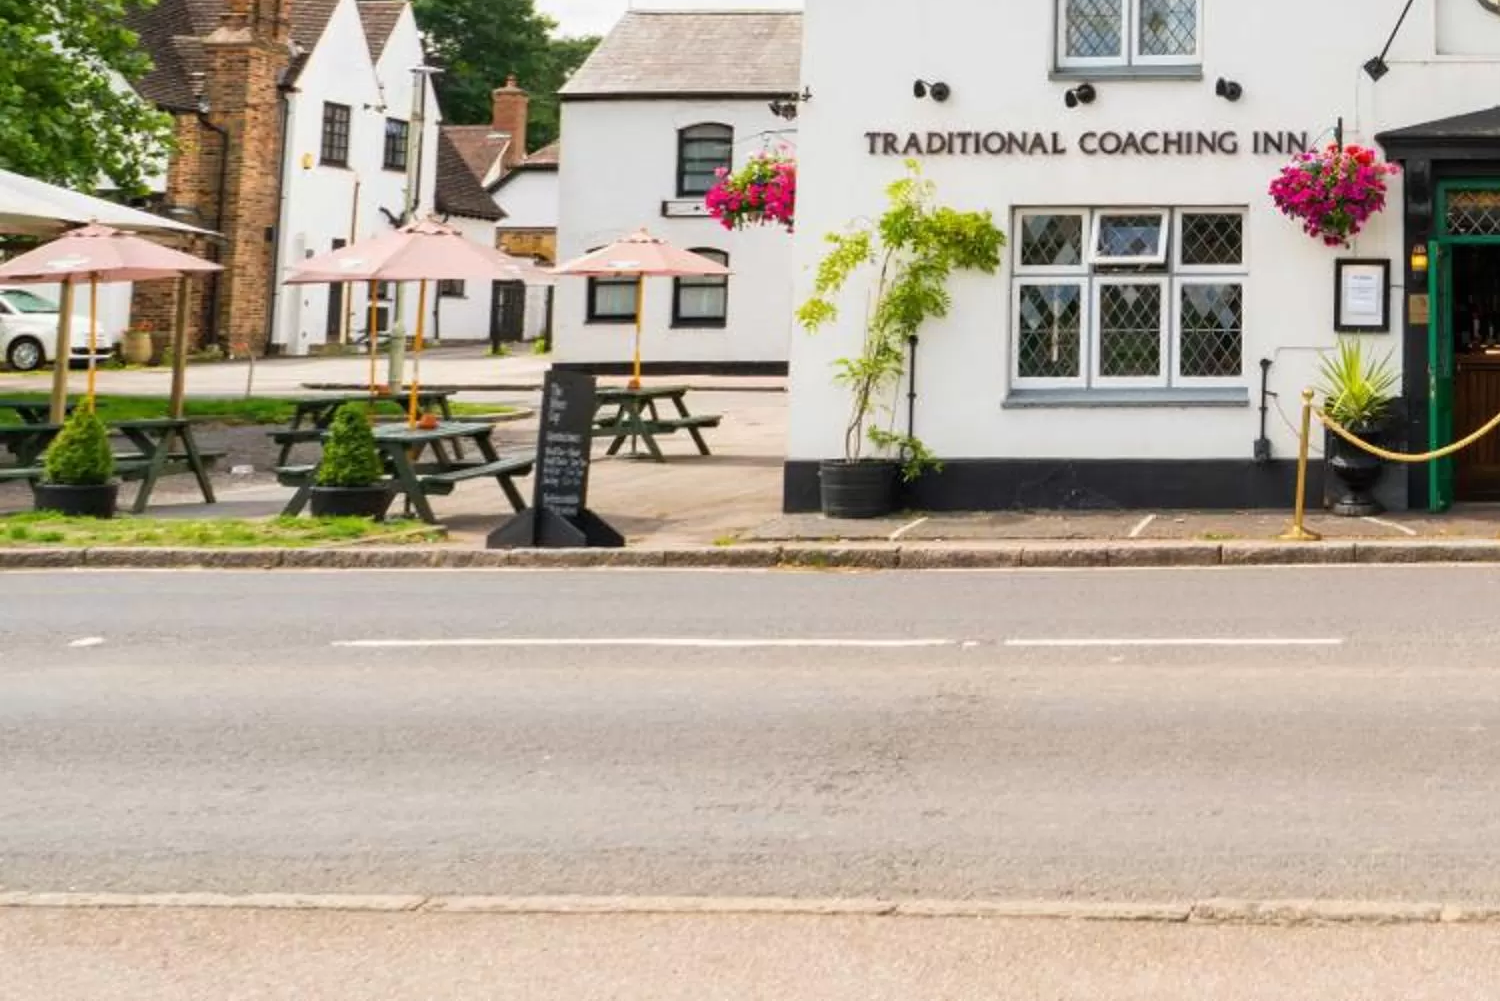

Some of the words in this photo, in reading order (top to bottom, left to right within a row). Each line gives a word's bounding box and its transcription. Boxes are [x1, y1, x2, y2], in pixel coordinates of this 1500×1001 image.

[865, 132, 1066, 154] TRADITIONAL
[1079, 132, 1237, 155] COACHING
[1252, 132, 1310, 155] INN
